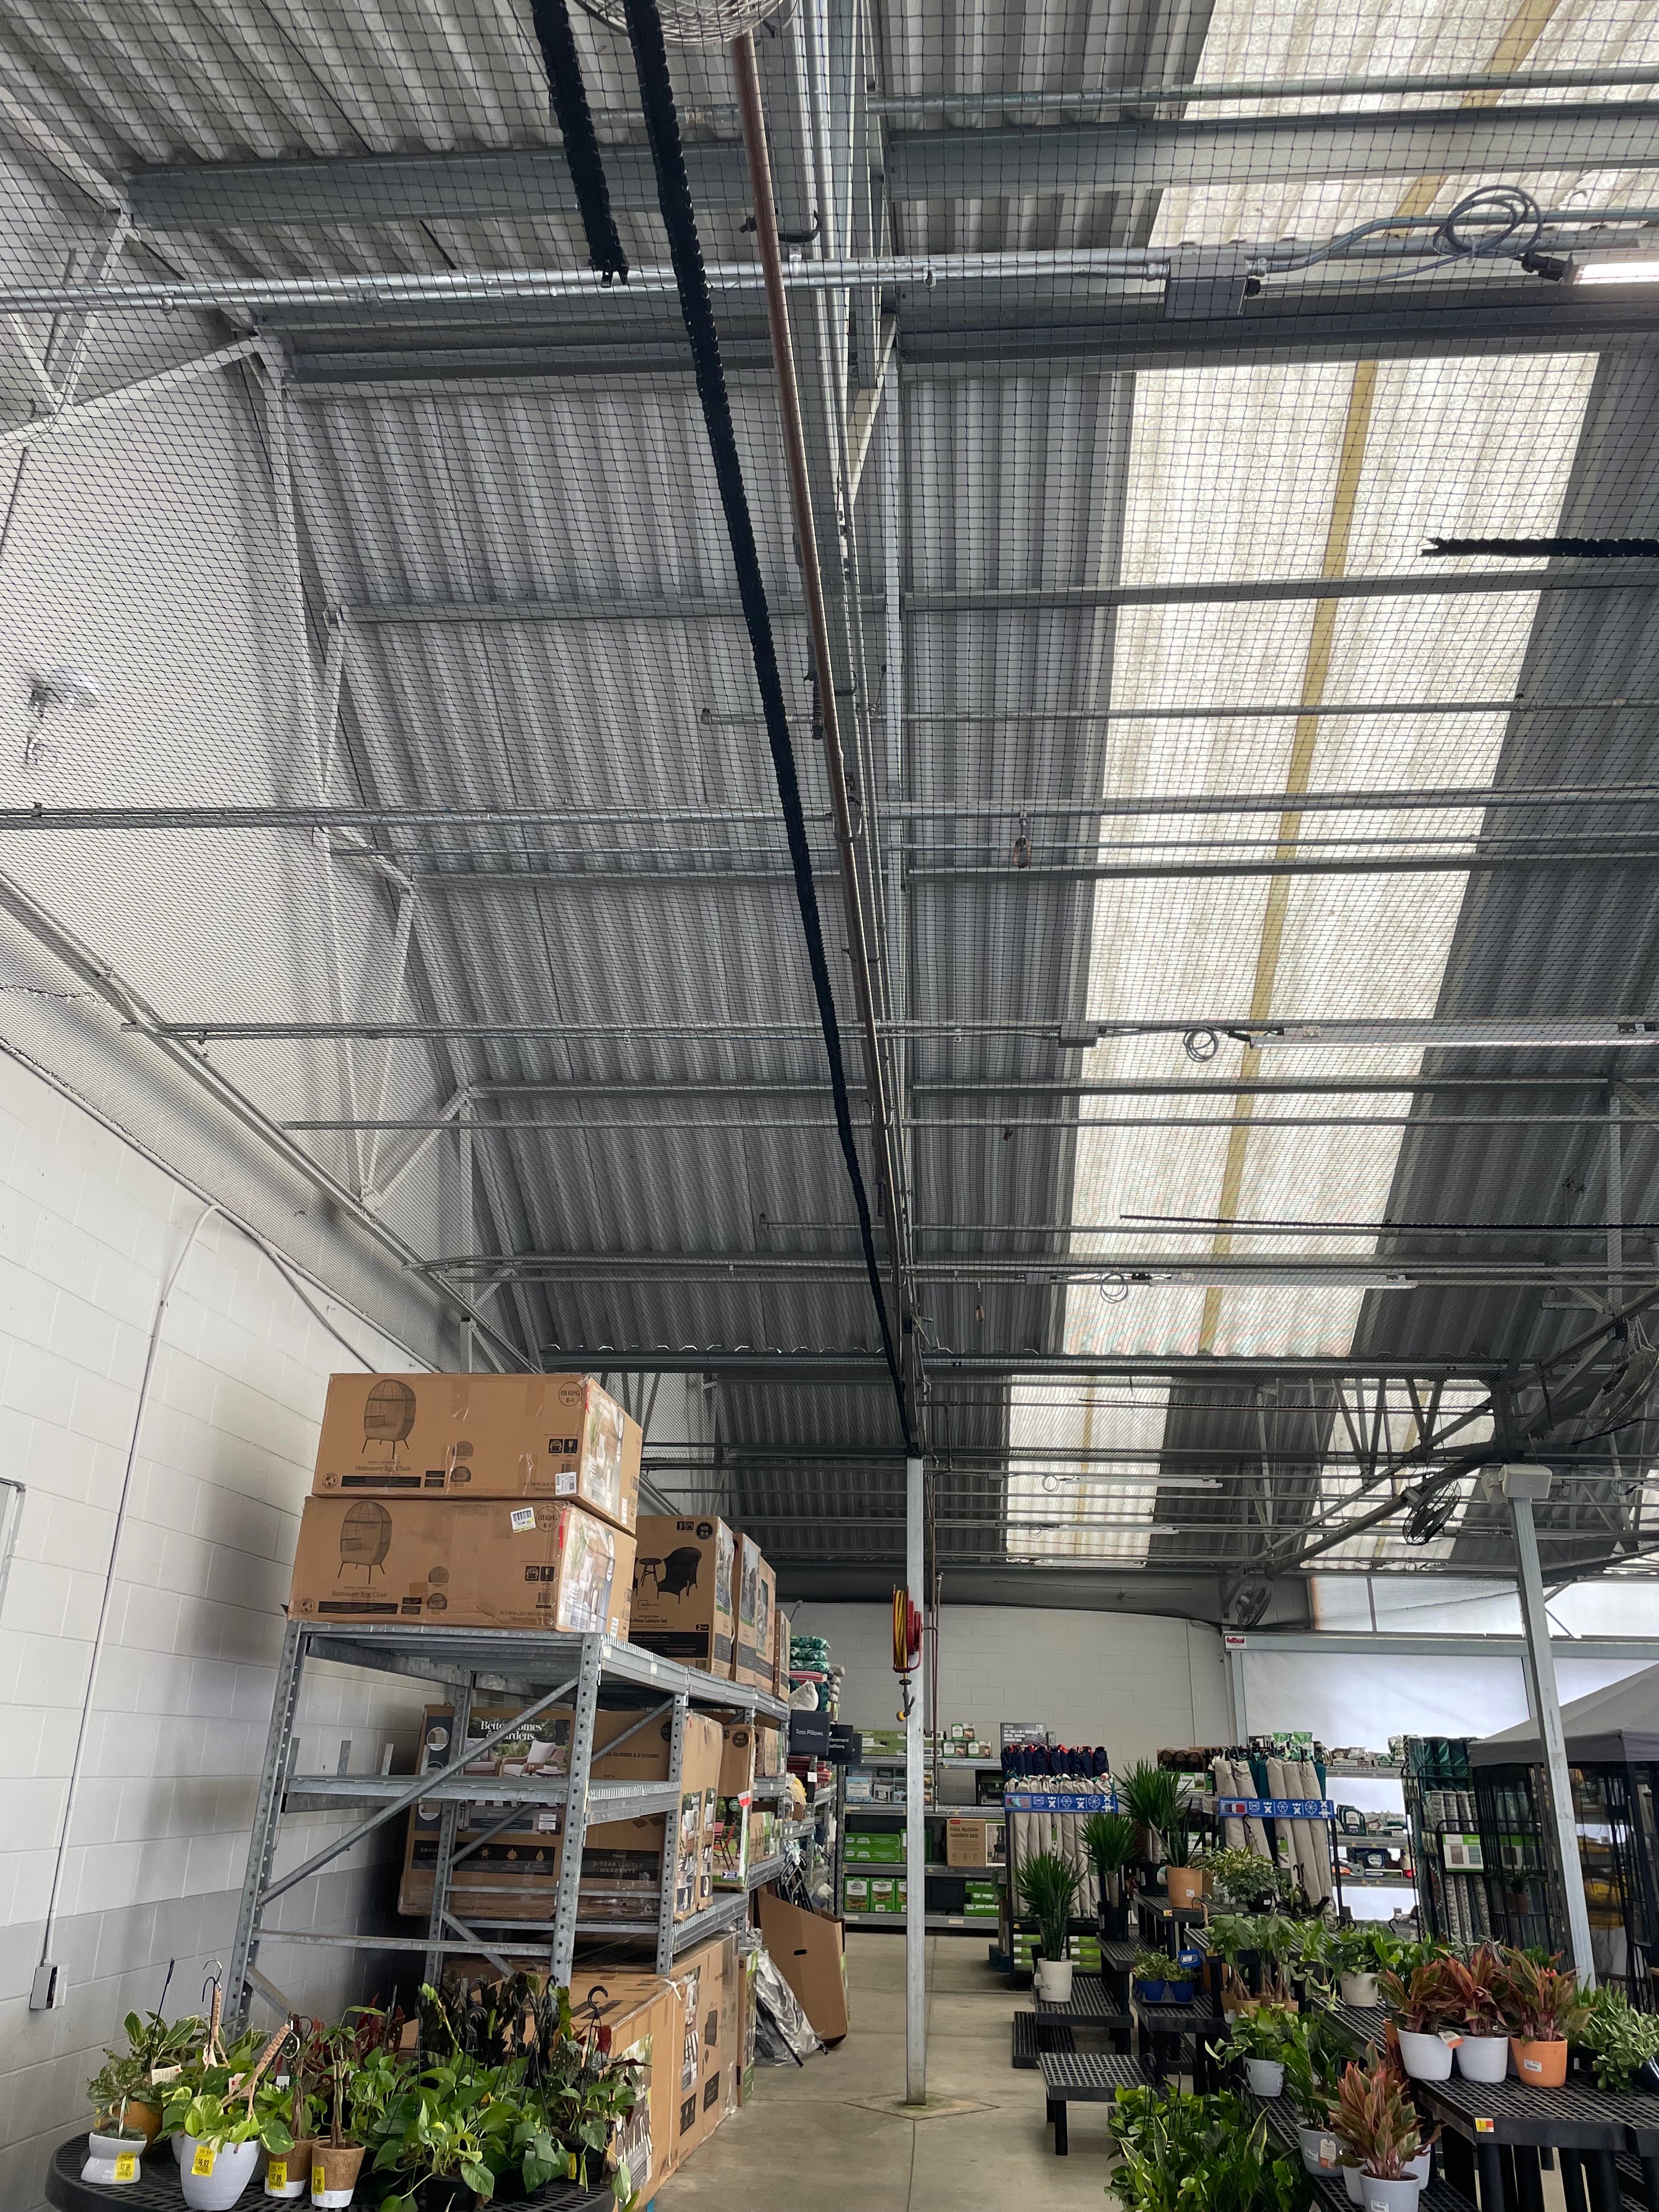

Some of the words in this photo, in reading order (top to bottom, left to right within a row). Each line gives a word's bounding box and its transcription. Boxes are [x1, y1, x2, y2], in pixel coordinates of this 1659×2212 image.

[481, 1720, 505, 1730] Bette
[517, 1723, 543, 1731] omes
[504, 1730, 535, 1740] ardens
[198, 2158, 210, 2168] $9.92
